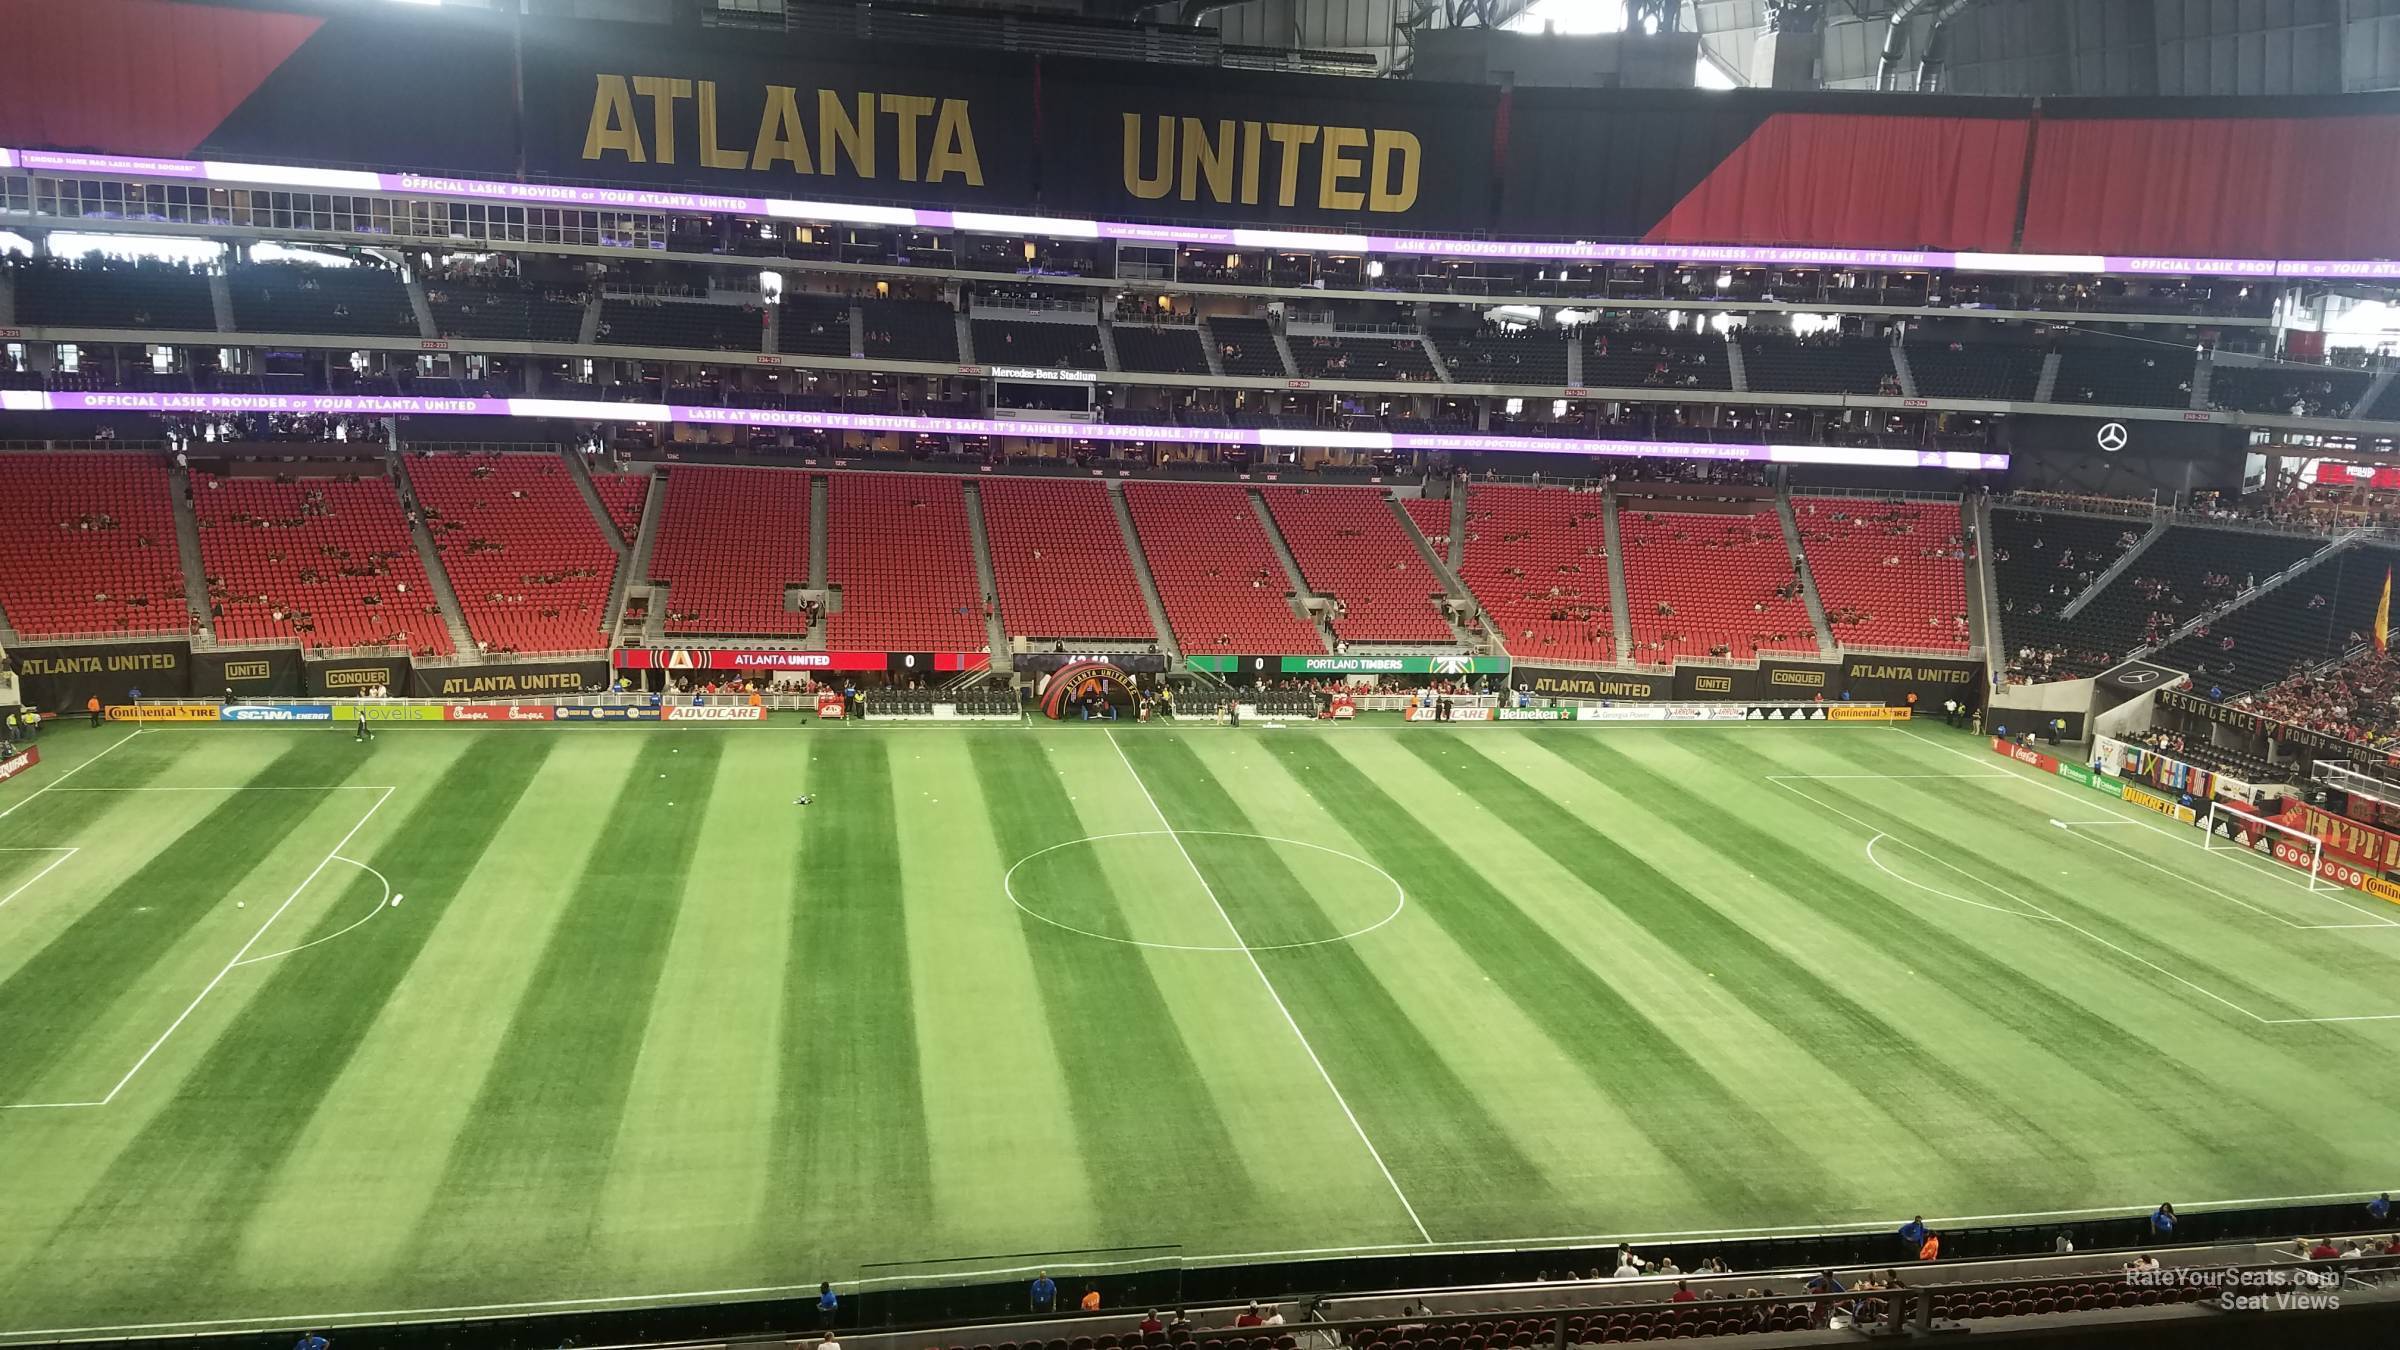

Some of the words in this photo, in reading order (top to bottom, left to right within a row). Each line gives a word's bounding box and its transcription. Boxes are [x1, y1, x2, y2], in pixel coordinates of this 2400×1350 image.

[581, 73, 985, 187] ATLANTA
[1122, 112, 1422, 213] UNITED
[402, 178, 464, 191] OFFICIAL
[469, 182, 506, 195] LASIK
[511, 185, 577, 199] PROVIDER
[581, 192, 595, 200] OF
[600, 190, 634, 202] YOUR
[639, 193, 695, 207] ATLANTA
[700, 196, 747, 210] UNITED
[1395, 241, 1425, 251] LASIK
[1428, 242, 1443, 251] AT
[1445, 243, 1509, 254] WOOLFSON
[1510, 245, 1532, 254] EYE
[1667, 247, 1688, 257] IT'S
[1755, 249, 1776, 259] IT'S
[1865, 252, 1887, 262] IT'S
[1892, 253, 1924, 263] TIME!
[2131, 260, 2191, 271] OFFICIAL
[2196, 261, 2233, 272] LASIK
[2238, 261, 2308, 273] PROVIDER
[2313, 265, 2326, 273] OF
[2332, 262, 2370, 273] YOUR
[991, 366, 1058, 380] Mercedes-Benz
[1059, 369, 1097, 382] Stadium
[84, 394, 158, 406] OFFICIAL
[162, 395, 206, 407] LASIK
[212, 396, 288, 408] PROVIDER
[293, 400, 307, 408] OF
[313, 398, 353, 409] YOUR
[357, 399, 420, 410] ATLANTA
[424, 400, 476, 411] UNITED
[688, 409, 725, 419] LASIK
[729, 410, 745, 420] AT
[749, 412, 822, 423] WOOLFSON
[827, 414, 849, 424] EYE
[962, 420, 990, 431] SAFE.
[993, 421, 1016, 432] IT'S
[1020, 422, 1077, 434] PAINLESS.
[1082, 424, 1105, 435] IT'S
[1189, 429, 1210, 439] IT'S
[1212, 430, 1244, 440] TIME!
[1409, 437, 1435, 446] MORE
[1437, 438, 1461, 447] THAN
[1485, 439, 1529, 449] DOCTORS
[1531, 441, 1561, 450] CHOSE
[1583, 443, 1636, 453] WOOLFSON
[1638, 444, 1659, 453] FOR
[1662, 445, 1690, 454] THEIR
[1692, 446, 1716, 455] OWN
[21, 656, 103, 676] ATLANTA
[107, 653, 177, 672] UNITED
[735, 654, 787, 665] ATLANTA
[788, 655, 830, 666] UNITED
[905, 654, 915, 667] 0
[1255, 657, 1264, 670] 0
[1307, 658, 1358, 669] PORTLAND
[1360, 659, 1403, 670] TIMBERS
[229, 665, 267, 677] UNITE
[329, 671, 387, 685] CONQUER
[1774, 672, 1822, 685] CONQUER
[1850, 664, 1913, 680] ATLANTA
[1917, 667, 1970, 683] UNITED
[442, 675, 517, 694] ATLANTA
[521, 672, 582, 690] UNITED
[1066, 670, 1096, 692] ATLANTA
[1101, 669, 1128, 685] UNITED
[1535, 678, 1596, 694] ATLANTA
[1600, 681, 1651, 698] UNITED
[1699, 679, 1728, 689] UNITE
[108, 706, 177, 719] Continental
[189, 708, 217, 717] TIRE
[237, 711, 292, 721] SCANA
[296, 713, 330, 721] ENERGY
[352, 705, 424, 720] Novelis
[673, 707, 760, 720] ADVOCARE
[1499, 708, 1558, 720] Heineken
[1831, 708, 1880, 719] Continental
[2162, 690, 2255, 731] RESURGENCE
[2285, 728, 2326, 749] ROWDY
[2123, 786, 2176, 817] QUIKRETE
[2304, 808, 2383, 863] HYPE
